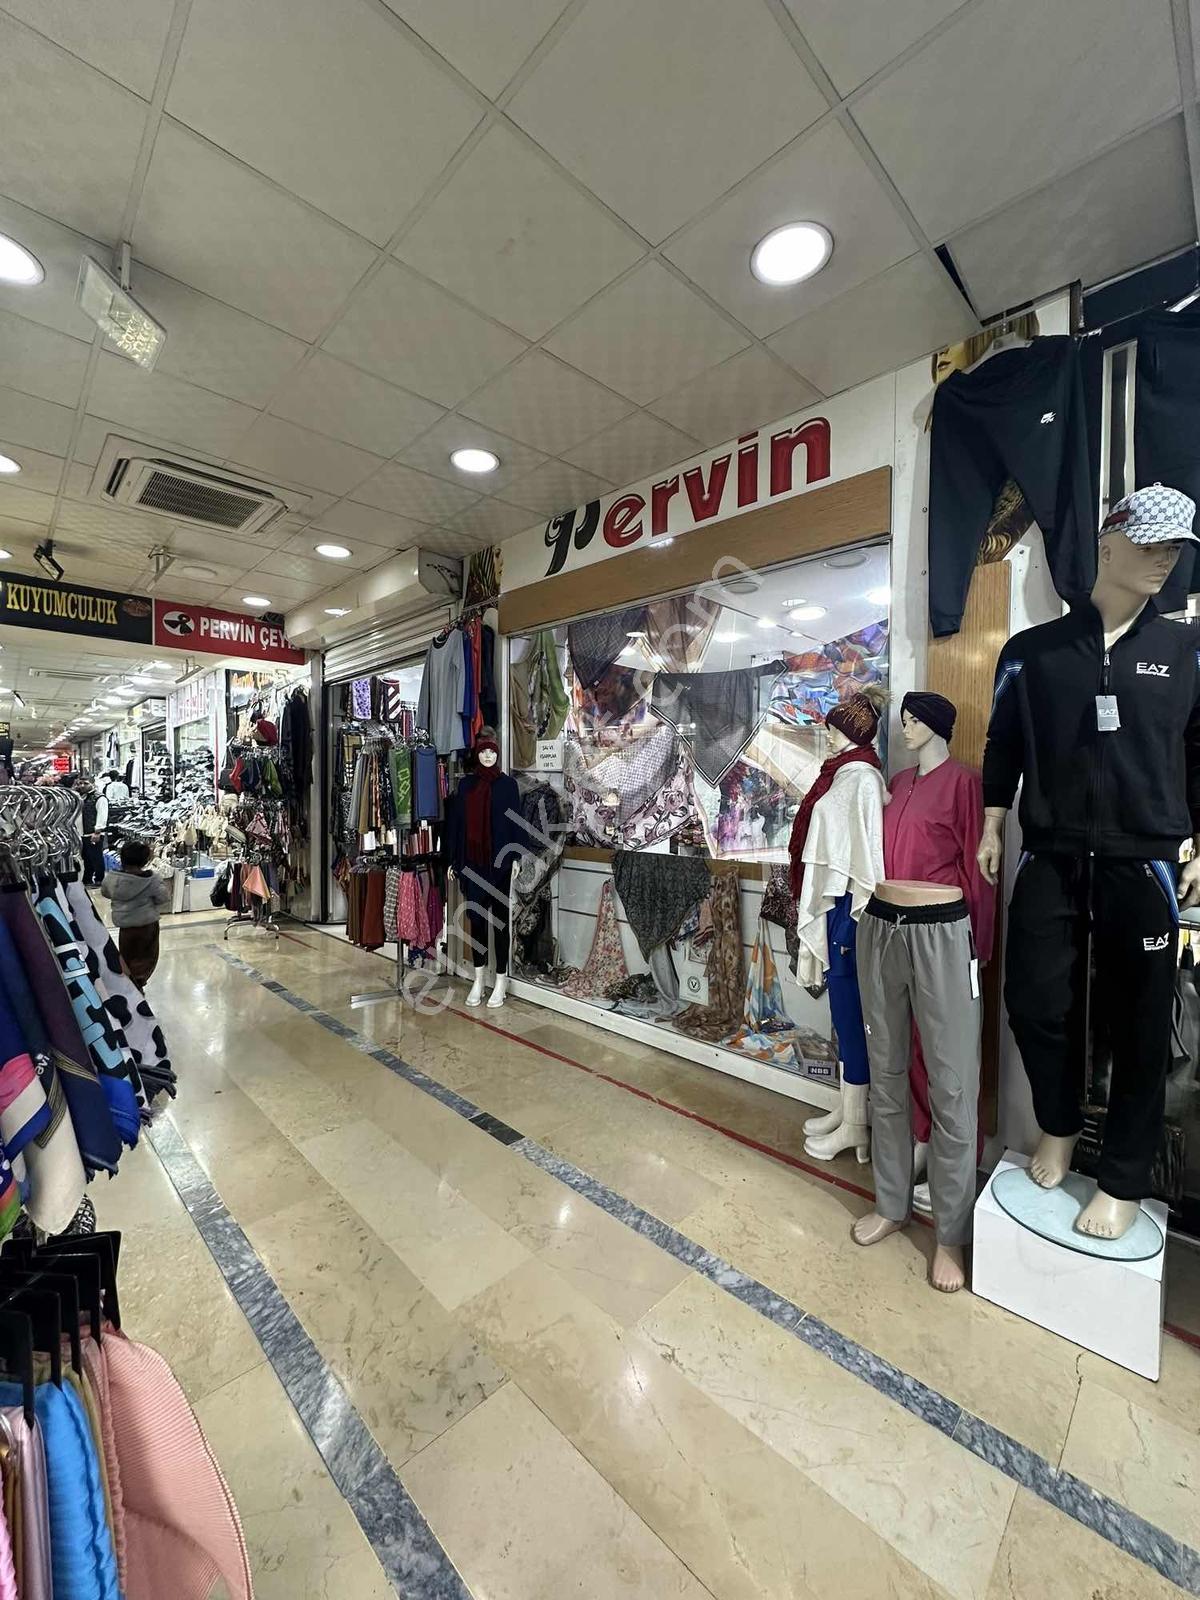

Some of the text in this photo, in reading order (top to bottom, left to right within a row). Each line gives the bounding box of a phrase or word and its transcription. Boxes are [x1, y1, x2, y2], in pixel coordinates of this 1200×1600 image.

[543, 415, 832, 577] Pervin
[6, 582, 118, 625] KUYUMCULUK
[200, 616, 256, 644] PERVİN
